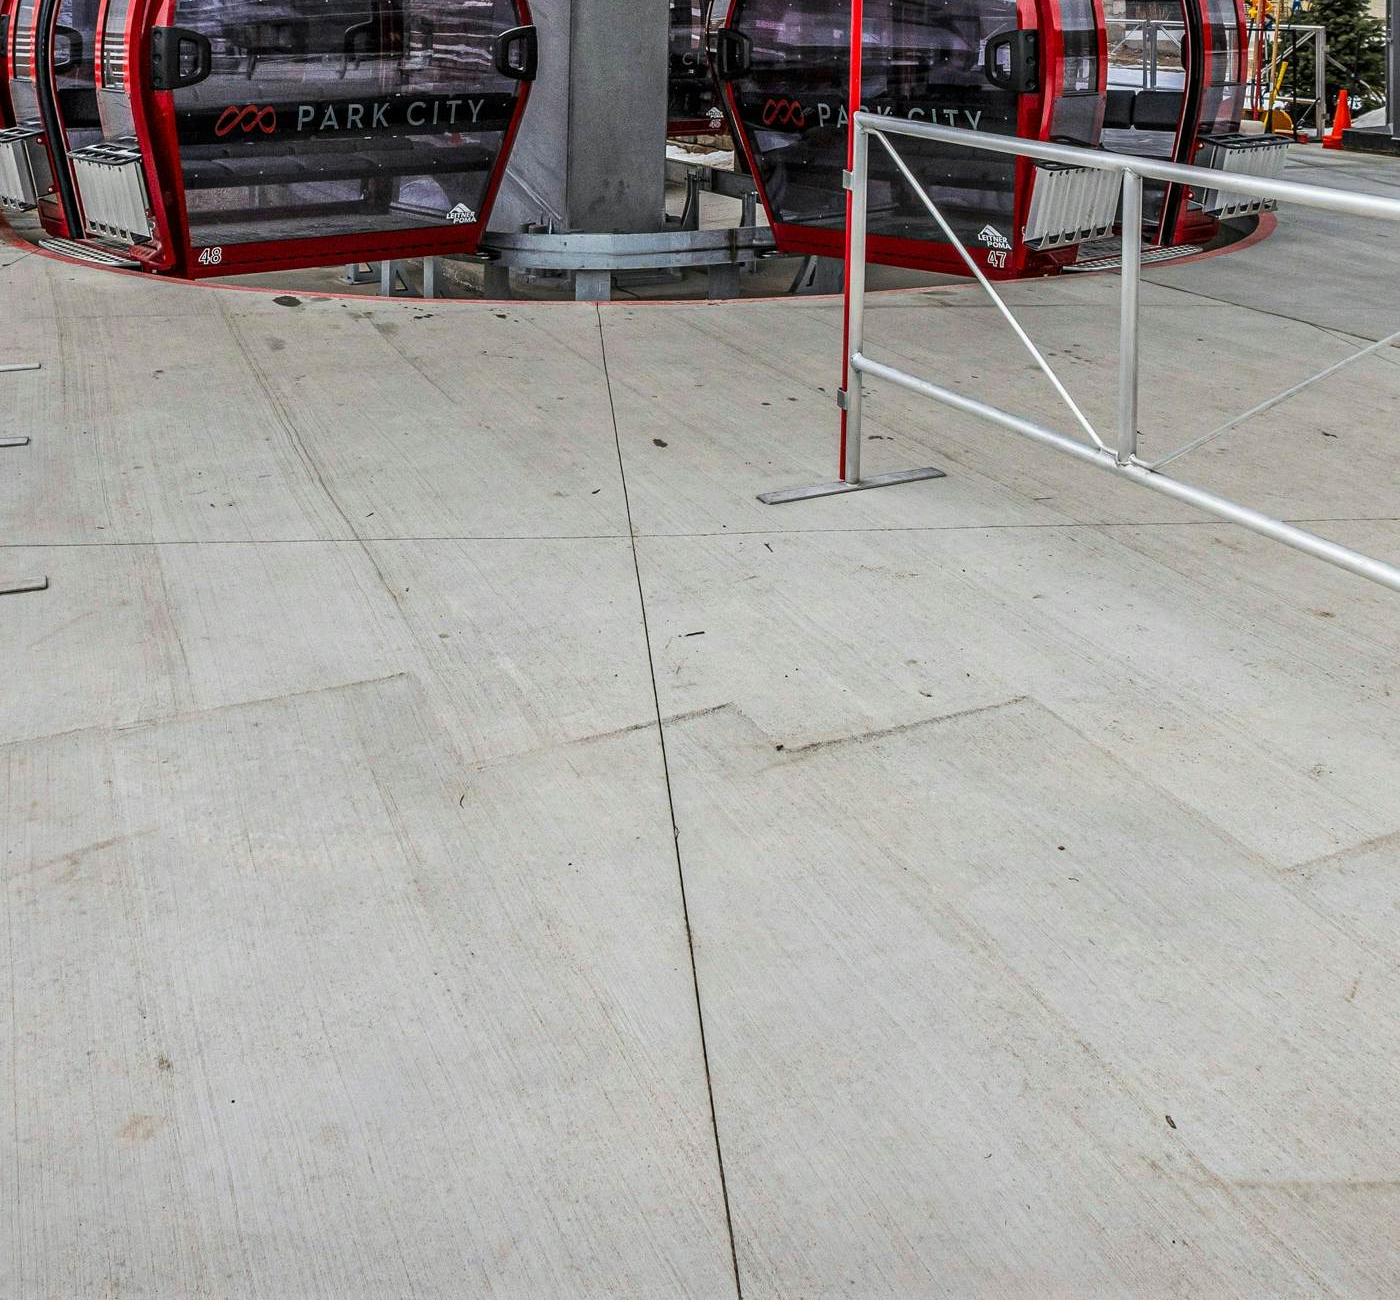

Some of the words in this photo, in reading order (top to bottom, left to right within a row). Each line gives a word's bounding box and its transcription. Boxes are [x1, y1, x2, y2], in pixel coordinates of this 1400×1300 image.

[297, 102, 390, 131] PARK
[406, 99, 485, 127] CITY
[446, 211, 476, 220] LEITNER
[977, 234, 1009, 243] LEITNER
[986, 240, 1013, 250] POMA
[198, 246, 222, 265] 48
[987, 250, 1007, 269] 47
